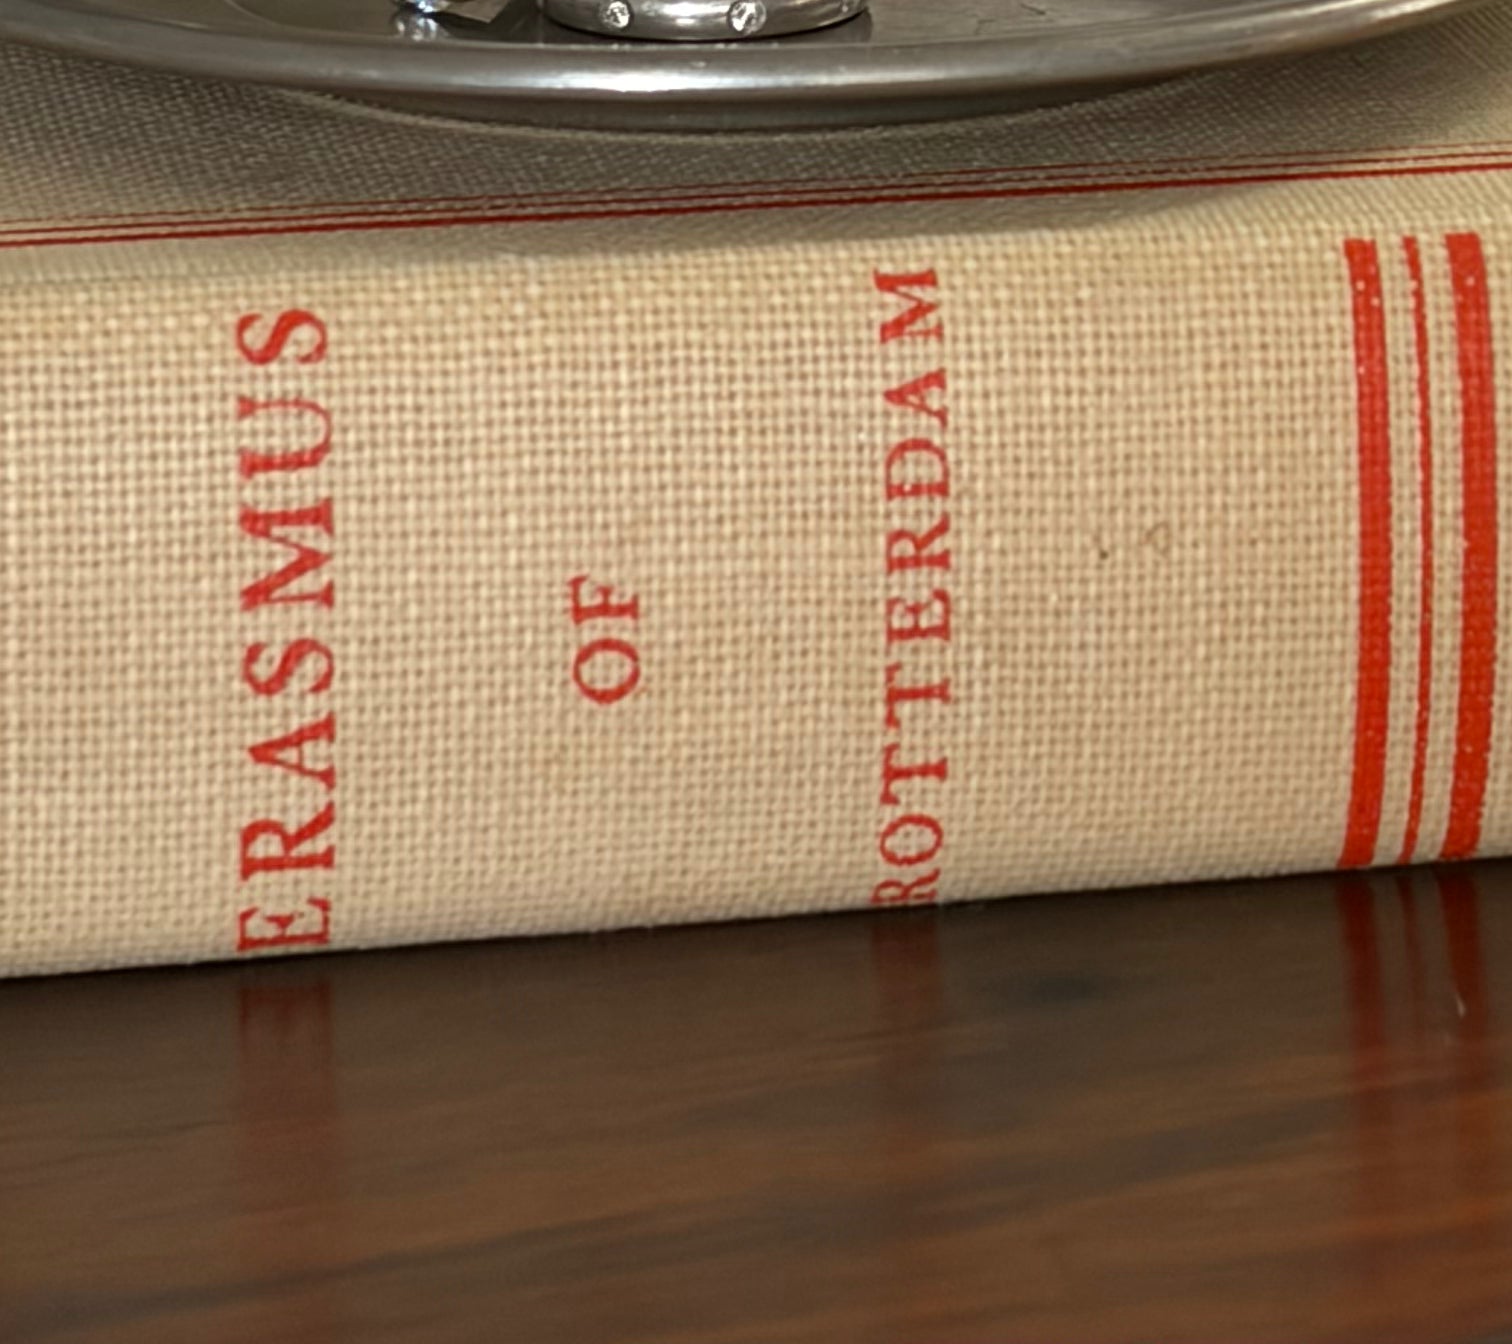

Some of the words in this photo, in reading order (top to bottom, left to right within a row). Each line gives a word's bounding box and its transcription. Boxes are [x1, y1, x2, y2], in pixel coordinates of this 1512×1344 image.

[236, 308, 337, 953] ERASMUS
[565, 574, 642, 705] OF
[870, 267, 953, 905] ROTTERDAM
